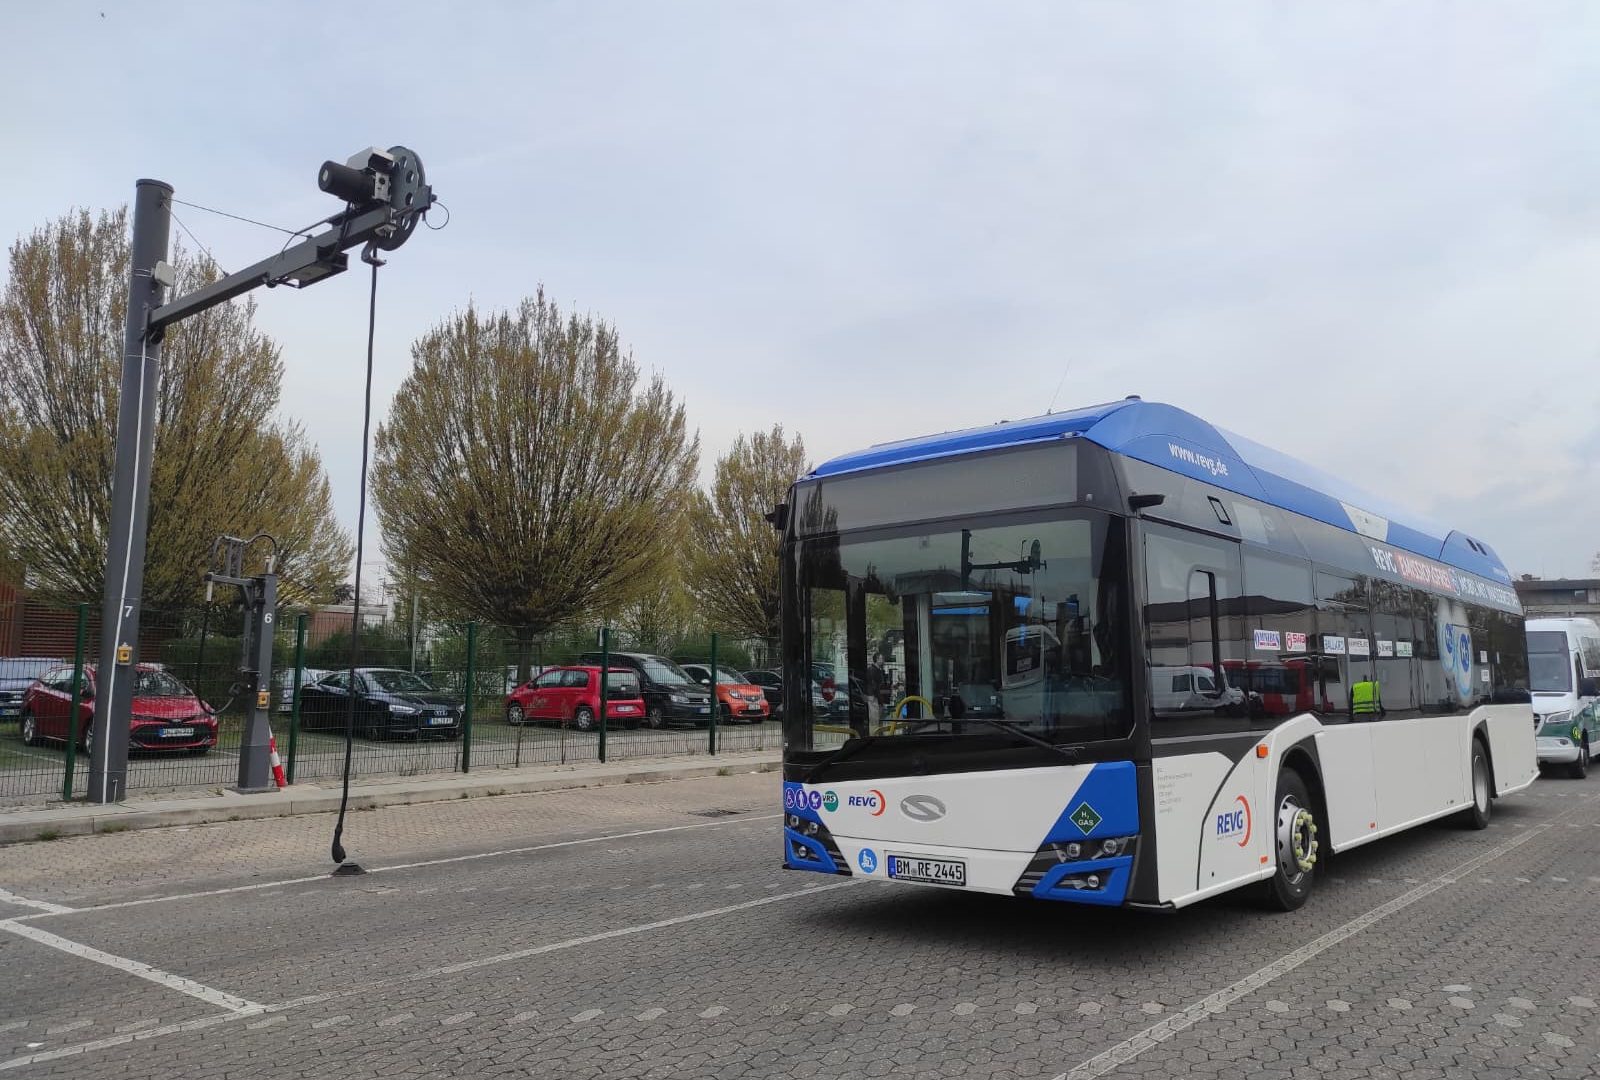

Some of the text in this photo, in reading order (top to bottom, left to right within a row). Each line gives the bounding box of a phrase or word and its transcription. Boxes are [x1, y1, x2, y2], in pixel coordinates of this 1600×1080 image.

[1168, 442, 1228, 476] www.revg.de
[124, 605, 133, 617] 7
[264, 612, 273, 624] 6
[822, 794, 835, 803] VRS
[848, 796, 877, 807] REVG
[1217, 810, 1244, 835] REVG
[896, 859, 910, 875] BM
[918, 861, 932, 878] RE
[934, 864, 963, 880] 2445
